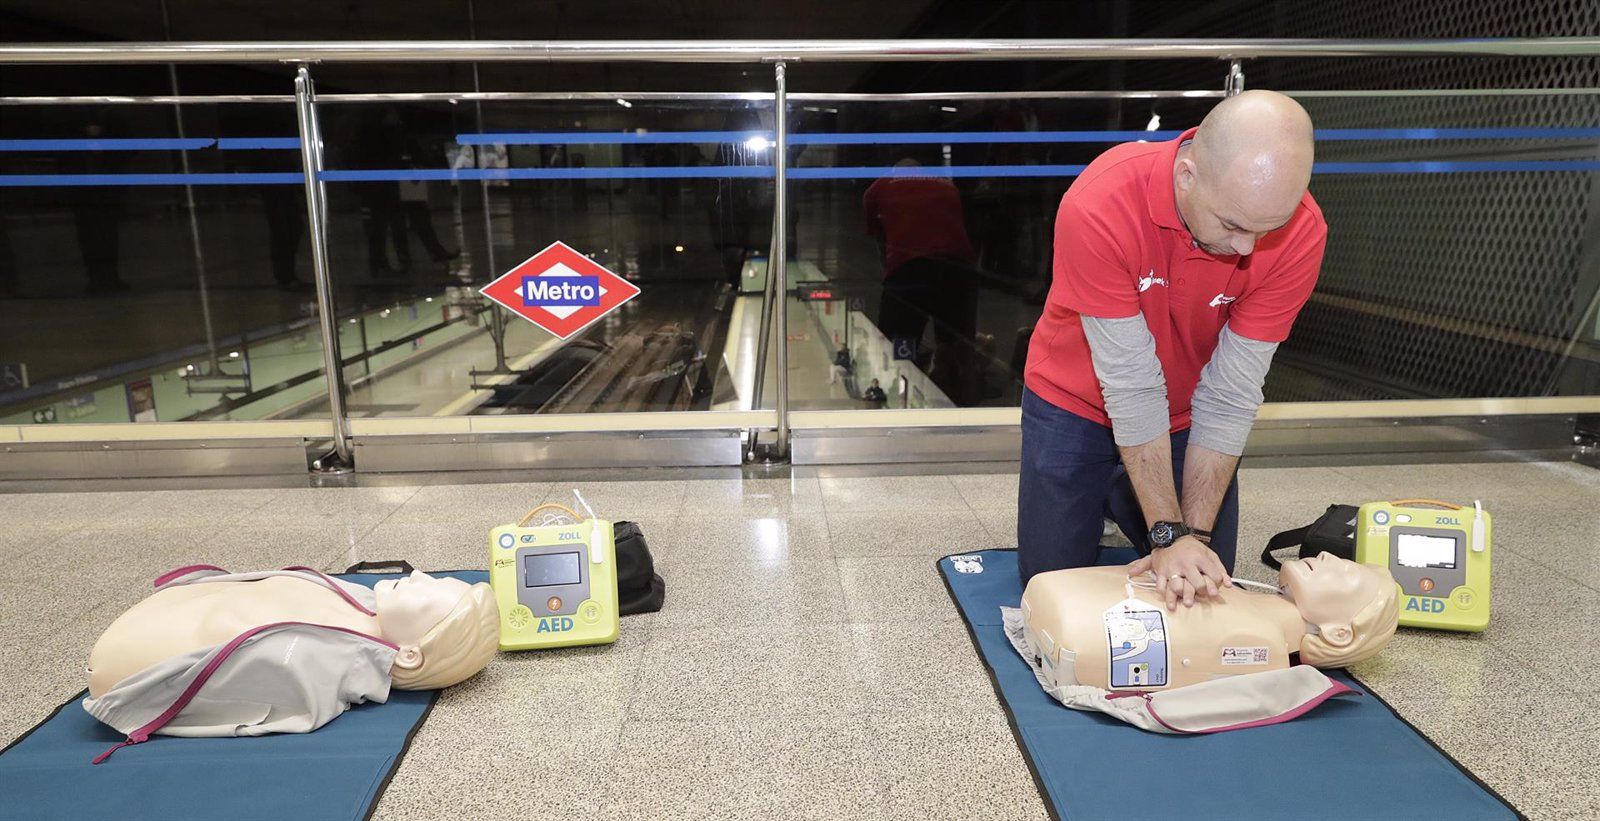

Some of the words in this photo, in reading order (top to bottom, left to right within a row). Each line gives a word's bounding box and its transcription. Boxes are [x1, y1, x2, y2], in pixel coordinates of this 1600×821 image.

[527, 281, 595, 300] Metro
[1436, 517, 1461, 525] ZOLL
[559, 532, 582, 540] ZOLL
[1405, 598, 1445, 613] AED
[537, 618, 574, 633] AED
